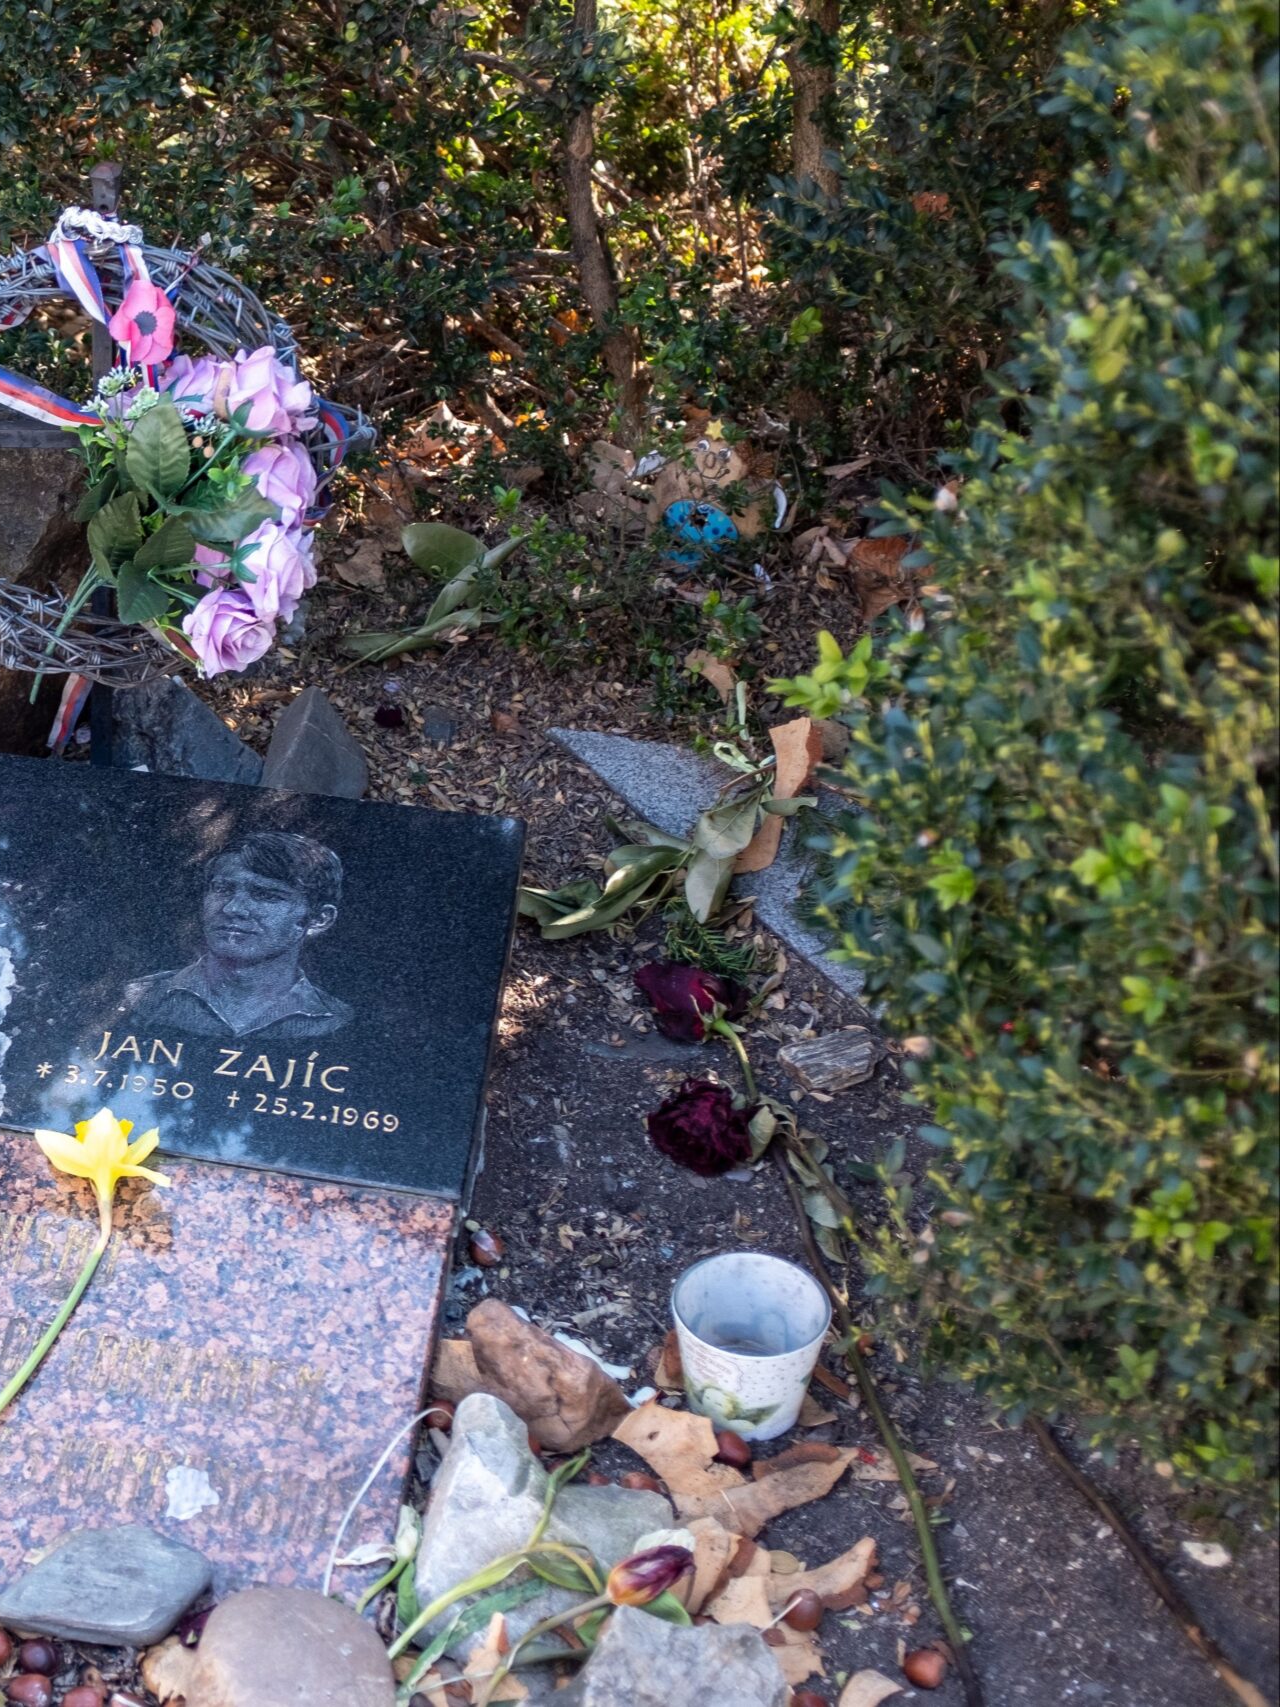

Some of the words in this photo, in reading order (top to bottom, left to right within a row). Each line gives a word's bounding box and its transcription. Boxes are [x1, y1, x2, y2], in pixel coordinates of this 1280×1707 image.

[63, 1064, 194, 1100] 3.7.1950
[93, 1031, 183, 1067] JAN
[214, 1049, 350, 1093] ZAJÍC
